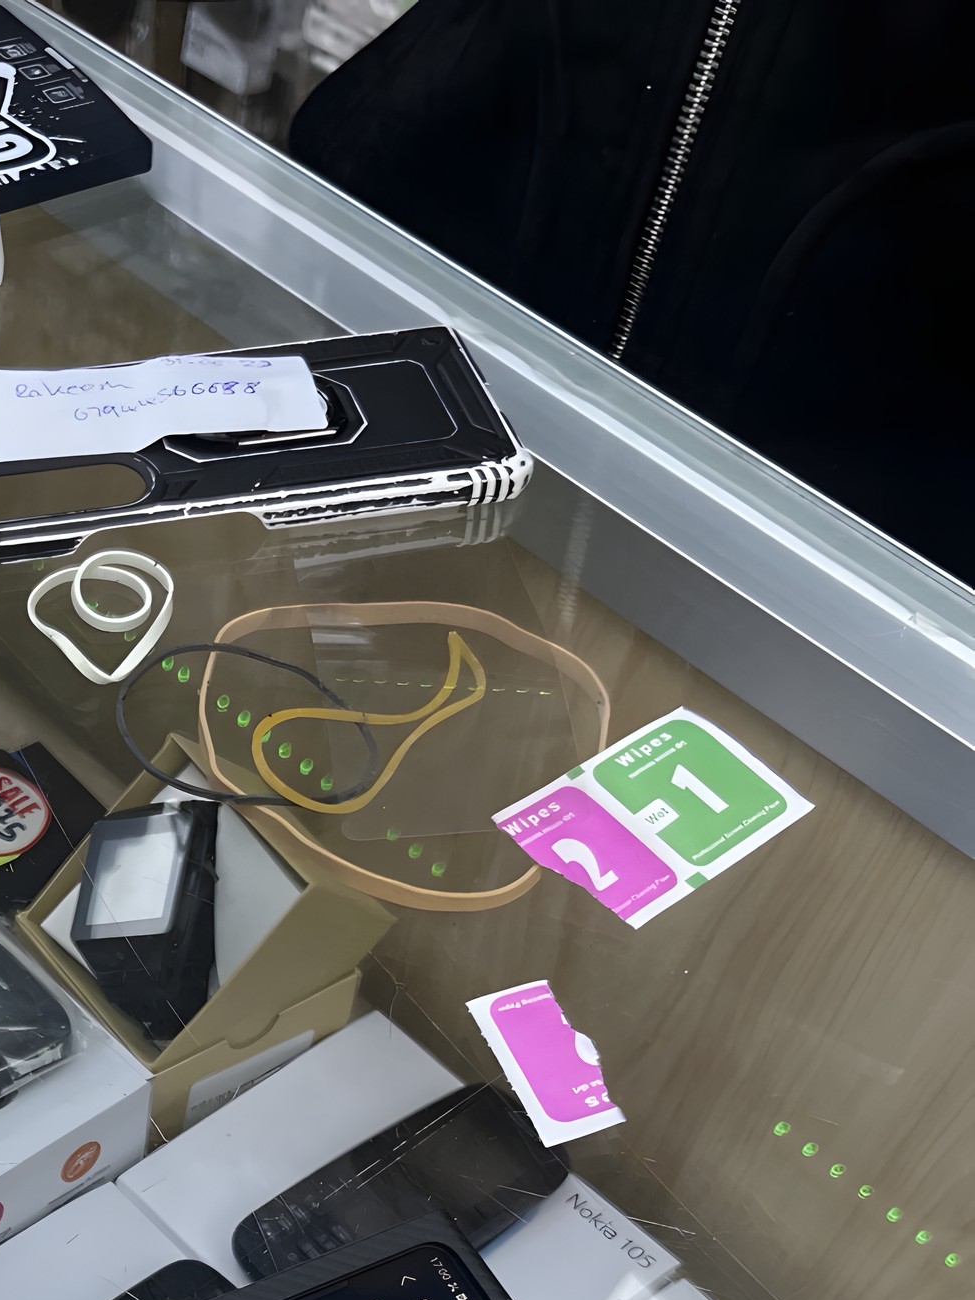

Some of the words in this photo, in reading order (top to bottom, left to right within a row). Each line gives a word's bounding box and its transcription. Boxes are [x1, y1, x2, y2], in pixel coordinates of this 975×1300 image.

[614, 732, 673, 767] Wipes
[670, 763, 730, 814] 1
[501, 801, 562, 837] Wipes
[551, 837, 620, 892] 2
[565, 1192, 618, 1241] Nokia
[621, 1238, 658, 1269] 105
